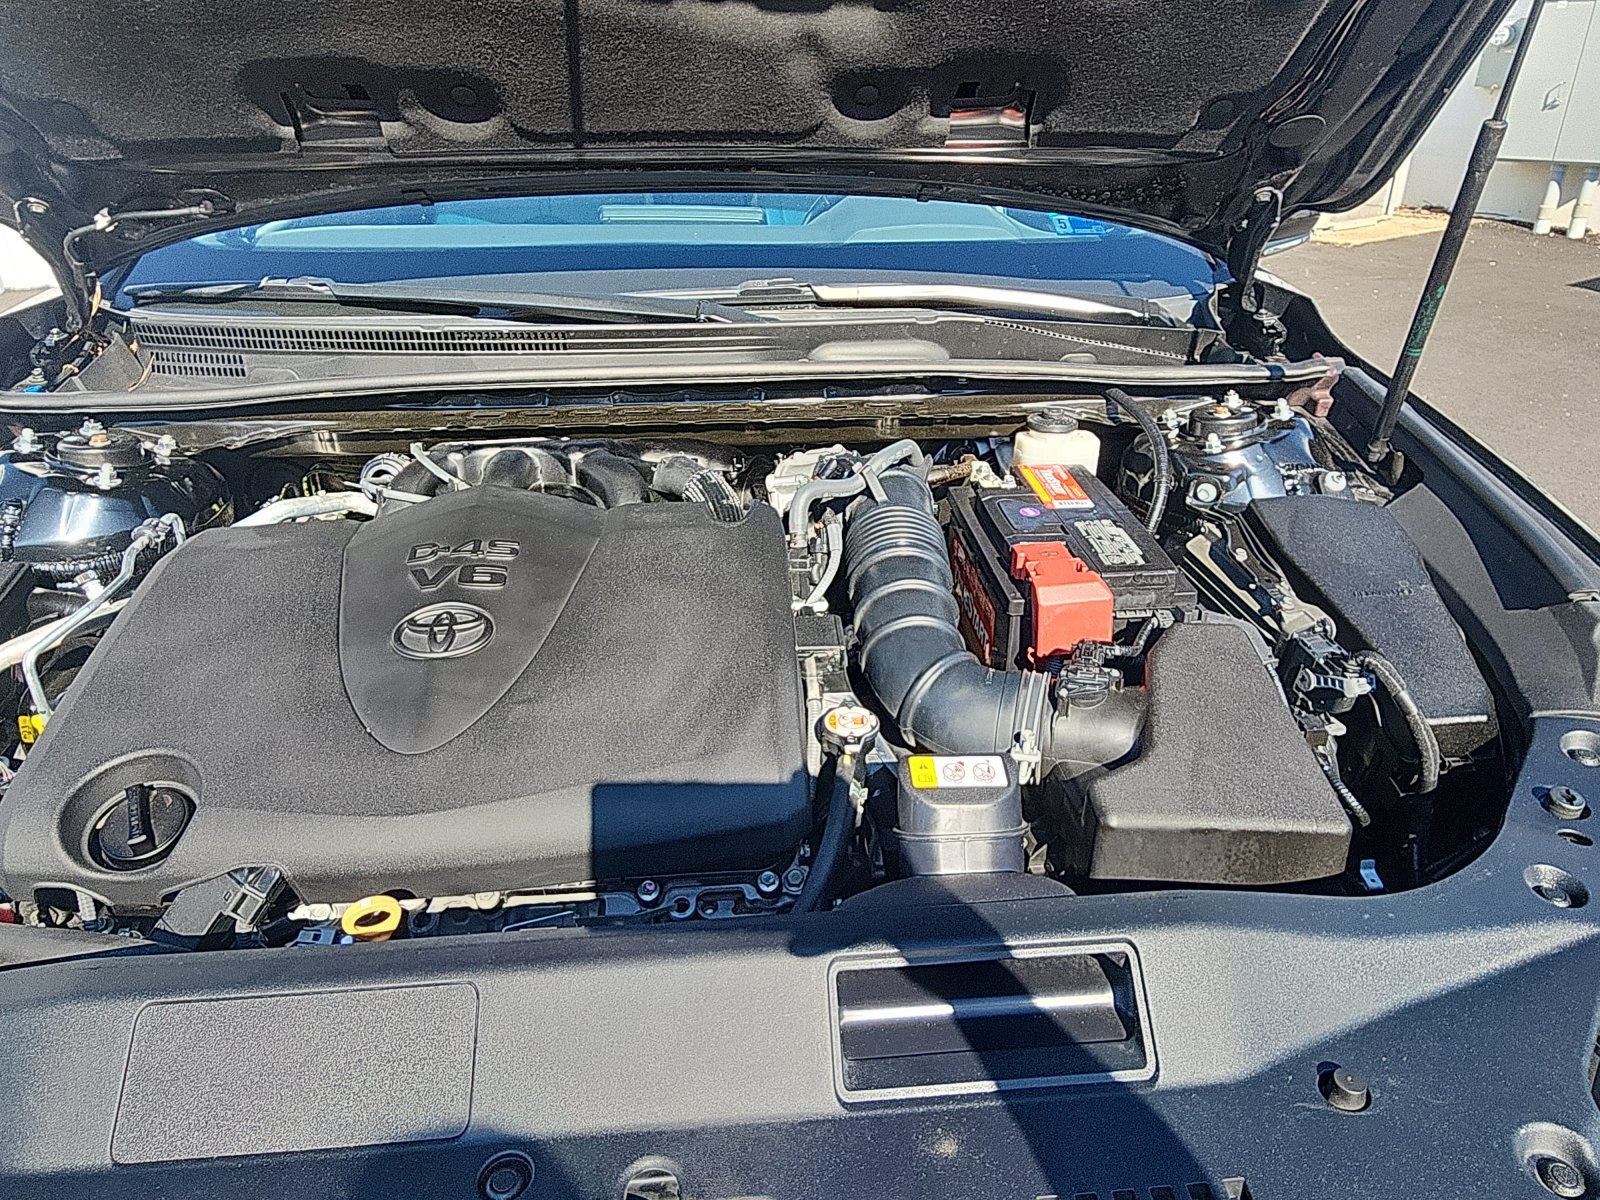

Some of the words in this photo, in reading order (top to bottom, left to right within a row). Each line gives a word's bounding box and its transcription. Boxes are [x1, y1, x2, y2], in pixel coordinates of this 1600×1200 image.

[1057, 218, 1068, 230] 5
[406, 538, 521, 565] D-4S
[409, 564, 508, 591] V6
